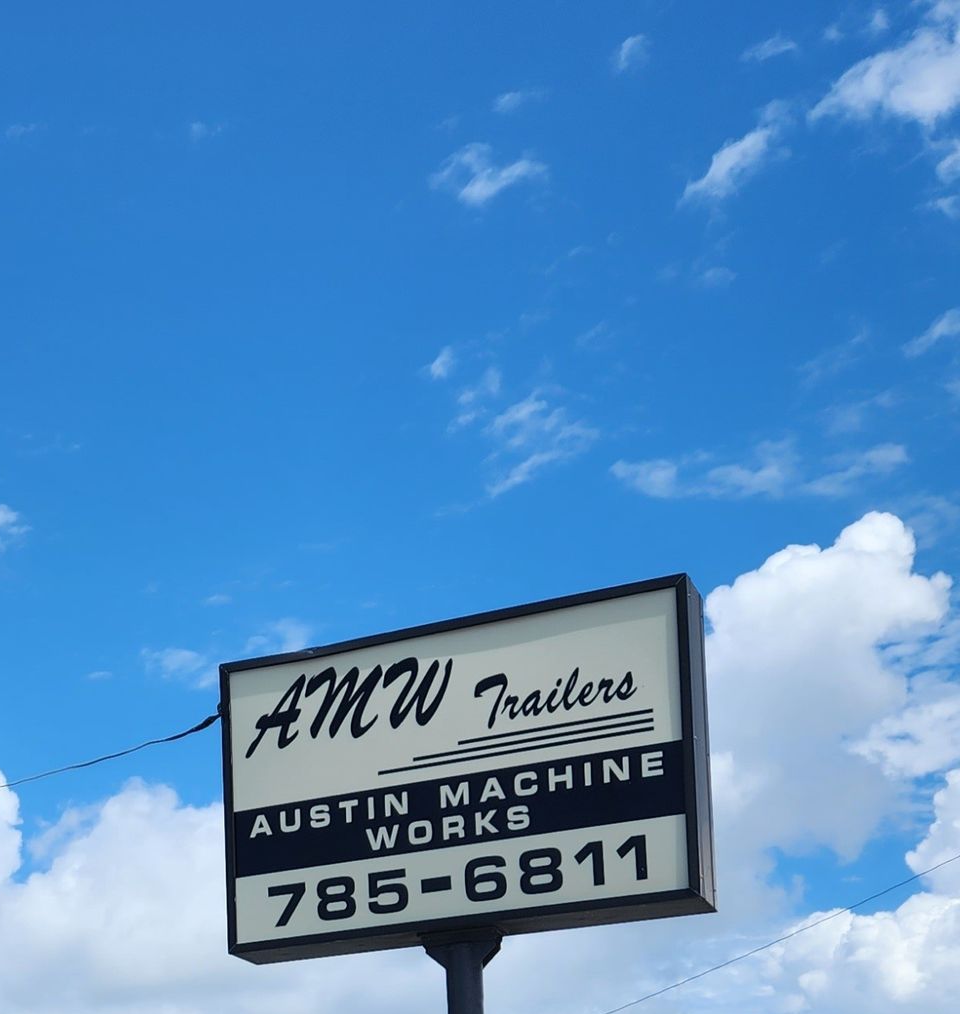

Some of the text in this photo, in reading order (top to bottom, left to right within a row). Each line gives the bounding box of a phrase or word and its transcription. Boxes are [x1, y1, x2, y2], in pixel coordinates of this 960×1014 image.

[246, 657, 637, 758] AMW Trailers
[250, 750, 664, 838] AUSTIN MACHINE
[365, 805, 530, 851] WORKS
[267, 834, 648, 928] 785-6811
